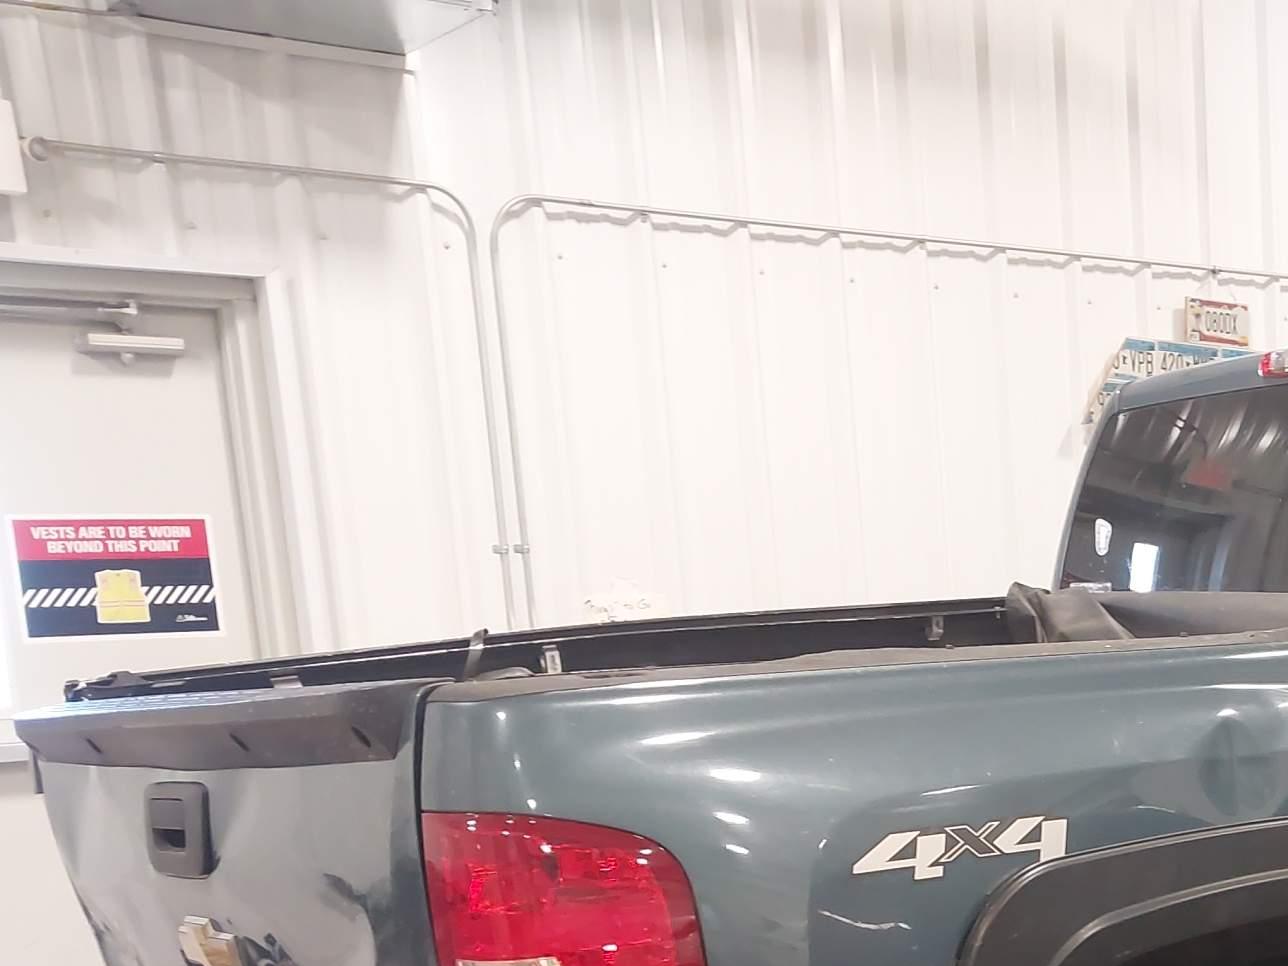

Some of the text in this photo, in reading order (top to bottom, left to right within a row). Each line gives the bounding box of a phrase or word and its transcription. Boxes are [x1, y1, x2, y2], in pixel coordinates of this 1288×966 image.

[30, 526, 192, 539] VESTS ARE TO BE WORN
[47, 539, 180, 553] BEYOND THIS POINT
